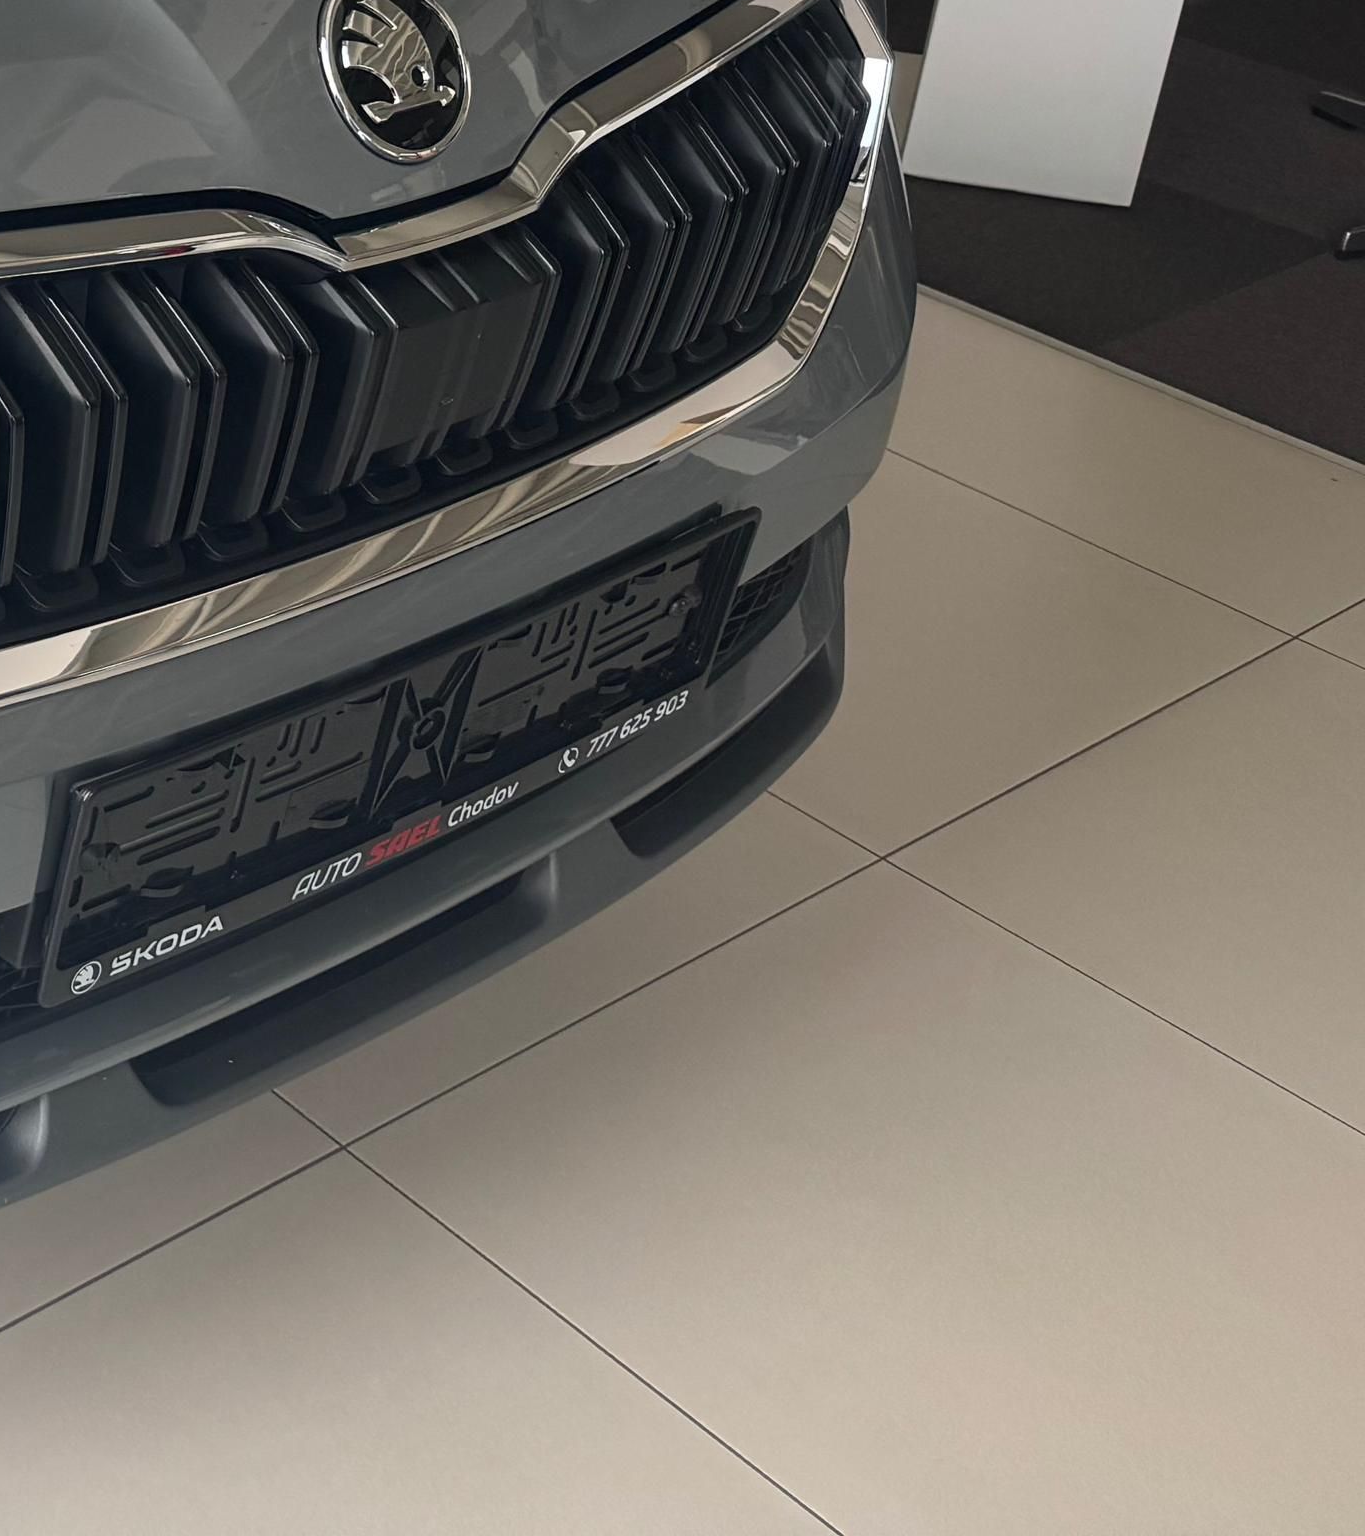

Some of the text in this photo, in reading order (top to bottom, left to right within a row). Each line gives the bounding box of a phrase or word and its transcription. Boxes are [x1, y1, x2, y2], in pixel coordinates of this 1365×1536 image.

[586, 690, 689, 757] 777 625 903
[291, 781, 519, 900] AUTO SAEL Chodov
